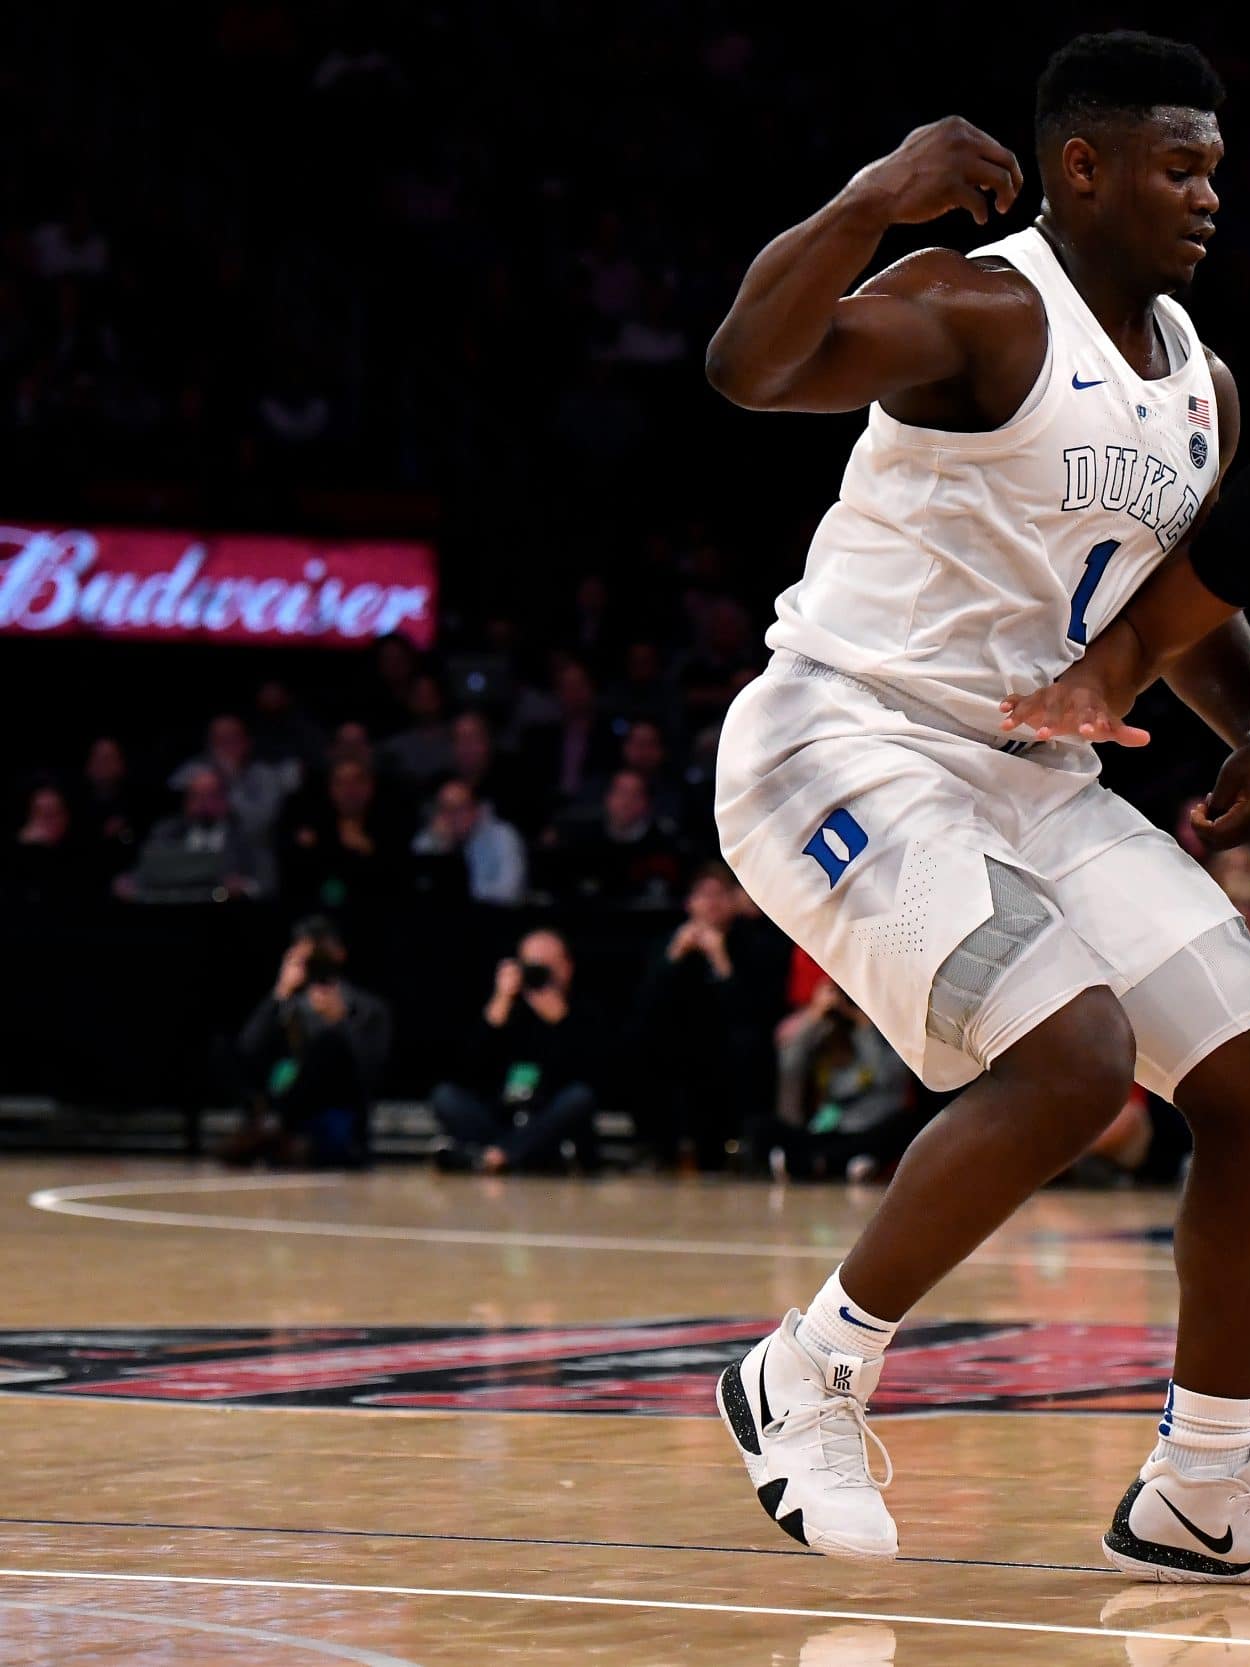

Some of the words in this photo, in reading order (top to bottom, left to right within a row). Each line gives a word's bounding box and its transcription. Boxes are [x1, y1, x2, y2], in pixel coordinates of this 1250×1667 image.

[1061, 445, 1201, 553] DUKE
[0, 526, 429, 637] Budweiser
[1066, 538, 1122, 646] 1
[801, 807, 869, 890] D
